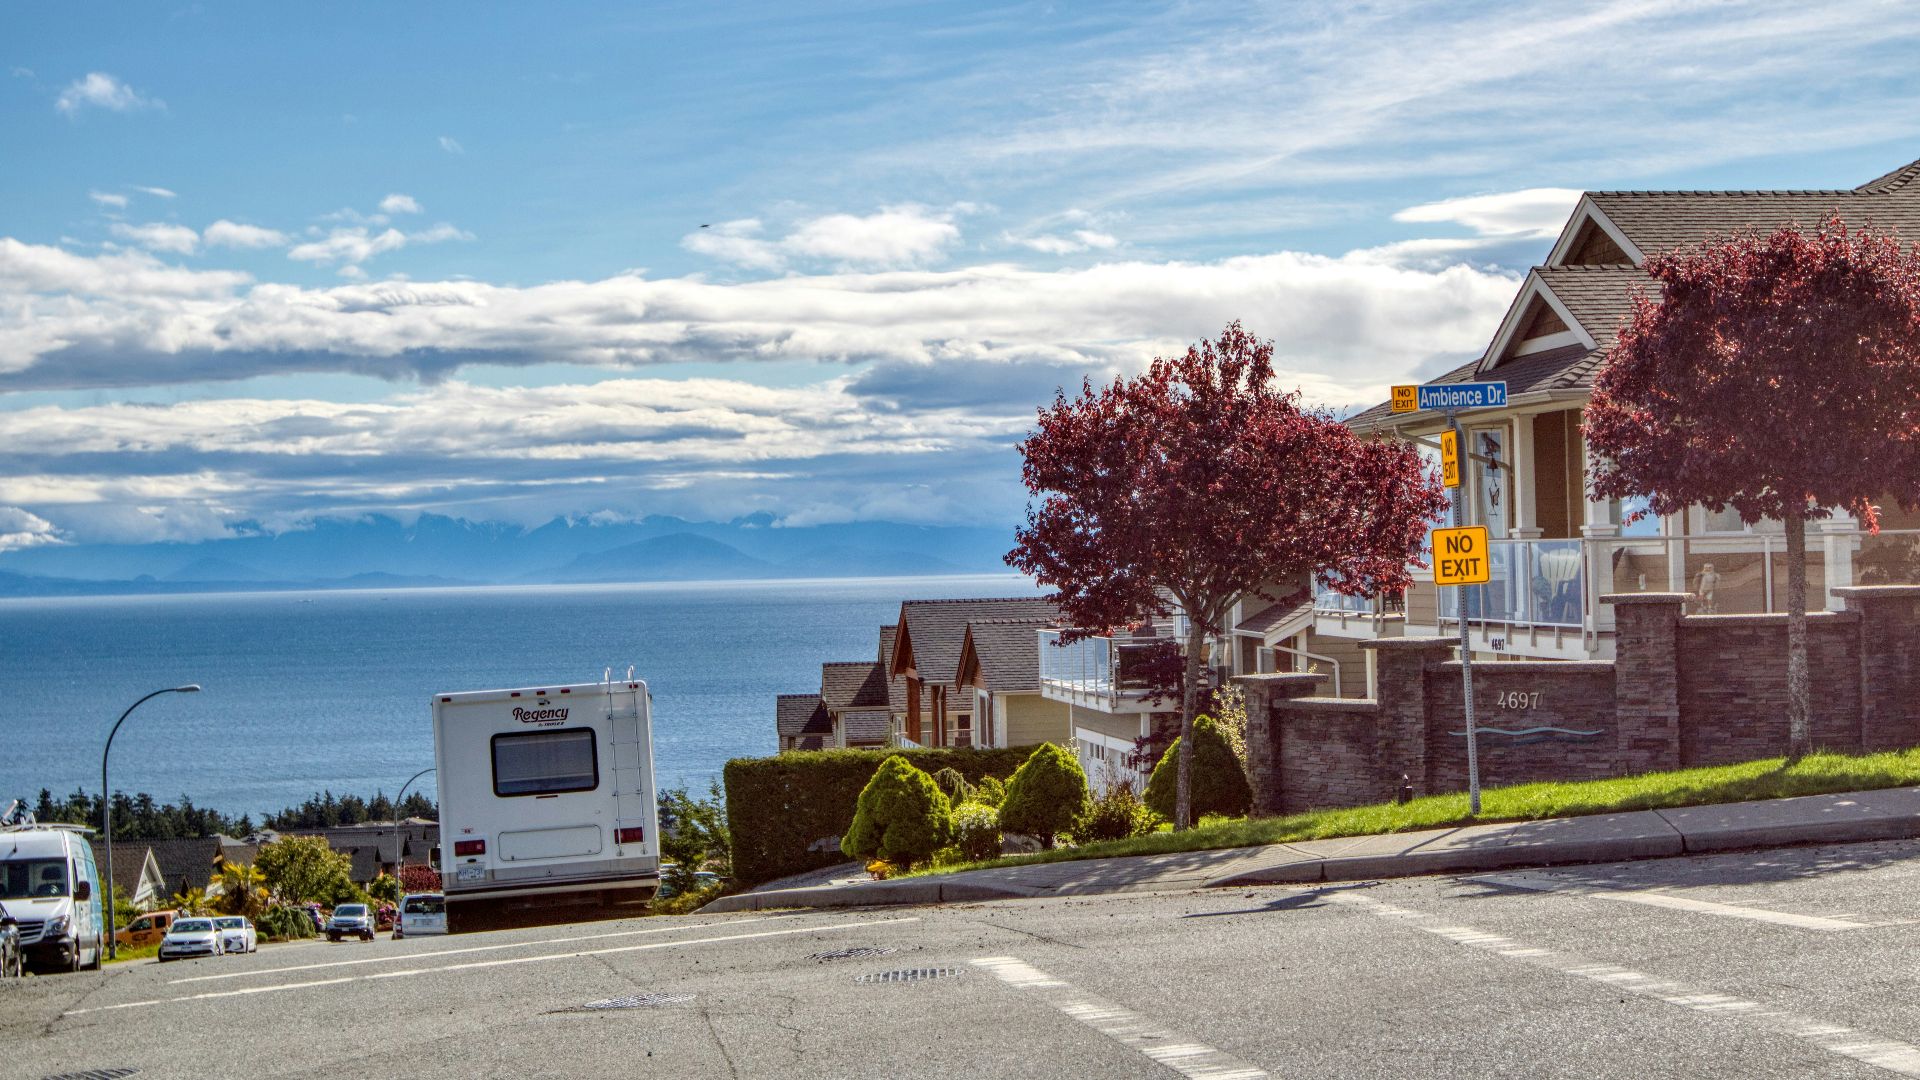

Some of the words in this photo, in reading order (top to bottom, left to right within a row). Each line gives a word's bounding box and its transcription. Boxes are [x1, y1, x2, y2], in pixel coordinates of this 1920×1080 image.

[1397, 388, 1411, 398] NO
[1420, 387, 1482, 407] Ambience
[1487, 385, 1506, 404] Dr.
[1395, 399, 1414, 409] EXIT
[1444, 437, 1453, 457] NO
[1444, 460, 1456, 480] EXIT
[1446, 534, 1473, 554] NO
[1441, 557, 1481, 578] EXIT
[1491, 638, 1505, 651] 4697
[1496, 691, 1540, 710] 4697
[512, 707, 569, 723] Regency
